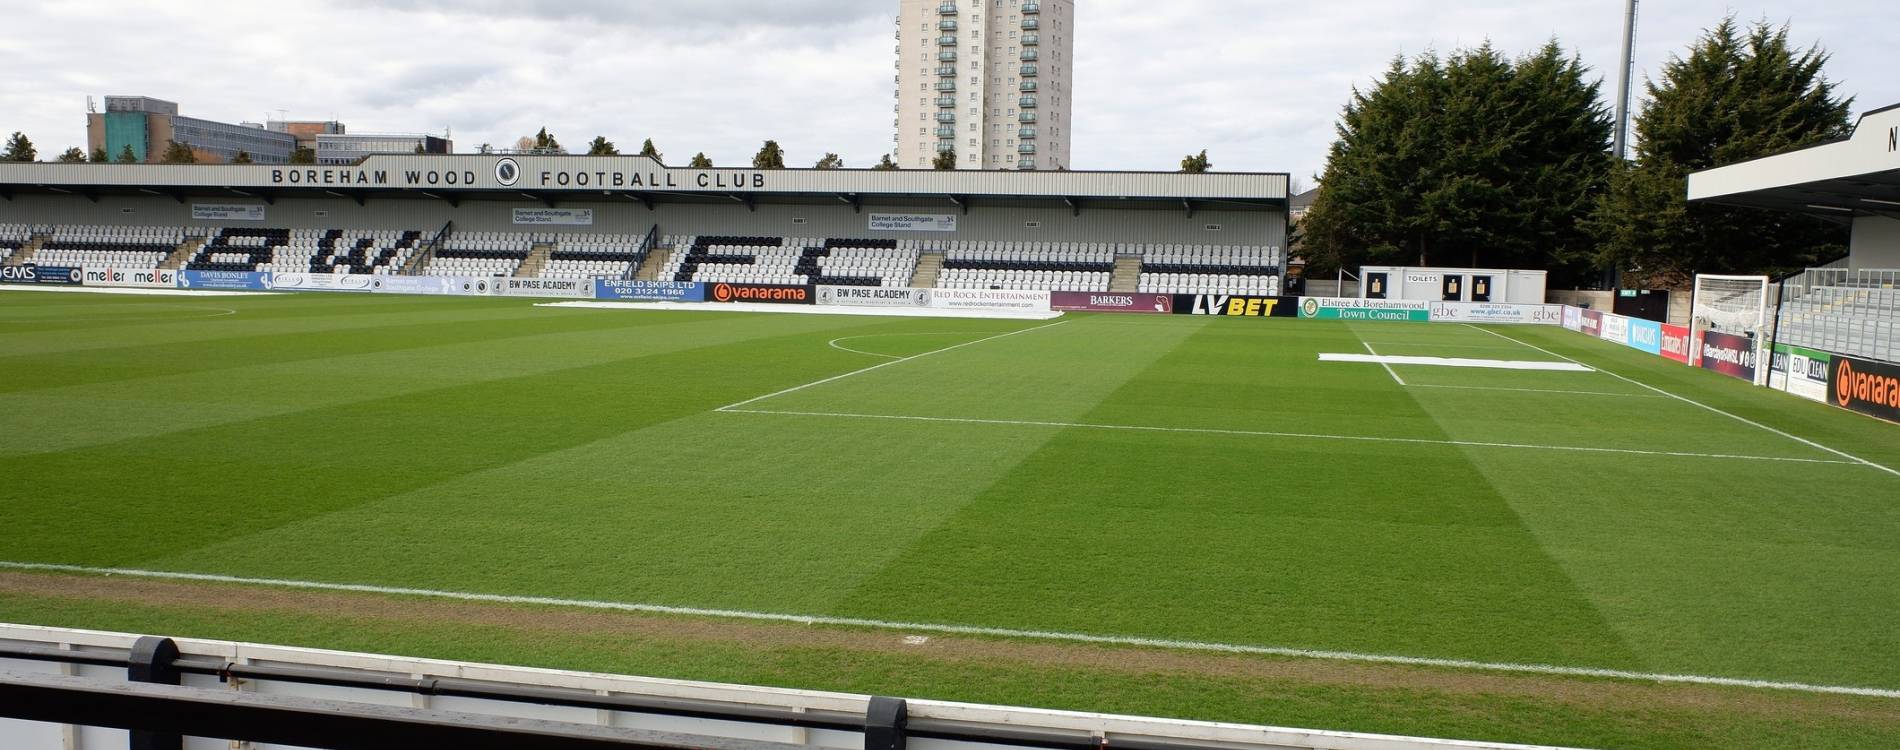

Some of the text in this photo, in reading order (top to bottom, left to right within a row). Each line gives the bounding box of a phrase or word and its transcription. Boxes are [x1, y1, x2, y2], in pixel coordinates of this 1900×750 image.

[272, 170, 765, 188] BOREHAM WOOD FOOTBALL CLUB
[87, 268, 125, 282] meller
[135, 269, 173, 283] meller
[509, 280, 576, 290] BW PASE ACADEMY
[604, 280, 695, 289] ENFIELD SKIPS LTD
[732, 287, 806, 300] vanarama
[837, 289, 911, 299] BW PASE ACADEMY
[934, 290, 1049, 301] RED ROCK ENTERTAINMENT
[1090, 295, 1133, 305] BARKERS
[1321, 298, 1425, 309] Elstree & Borehamwood
[1337, 308, 1410, 320] Town Council
[1661, 330, 1682, 354] Emirates
[1792, 357, 1828, 382] EDU CLEAN
